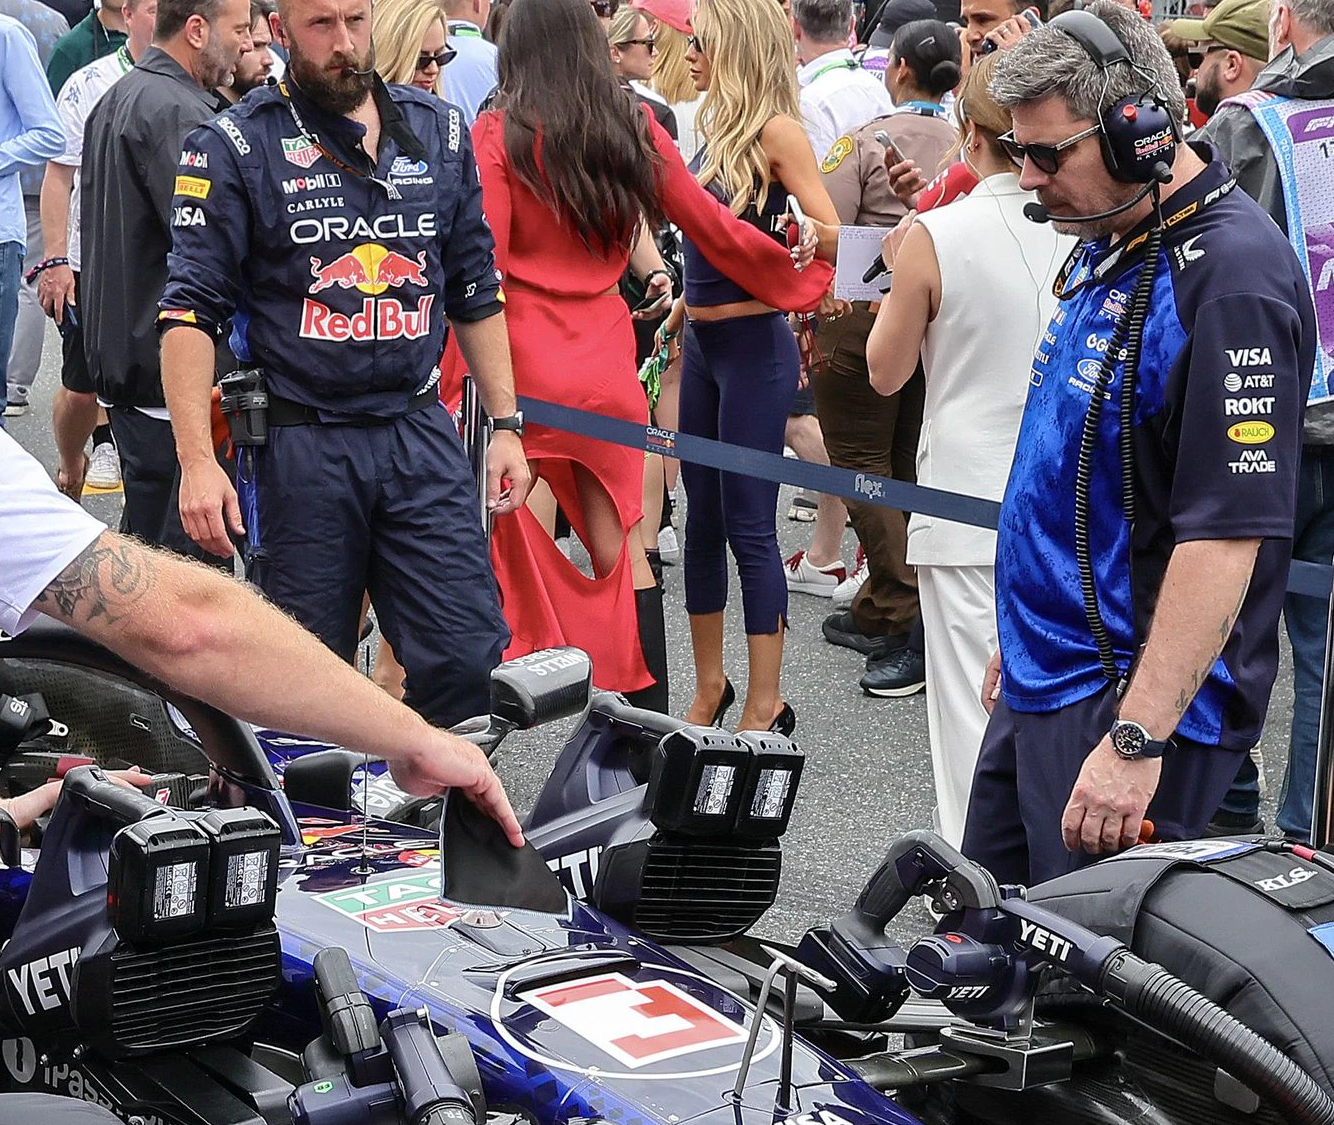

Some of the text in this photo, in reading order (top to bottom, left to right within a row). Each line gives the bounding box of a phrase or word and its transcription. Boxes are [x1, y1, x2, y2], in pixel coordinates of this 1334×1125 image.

[217, 117, 251, 156] sparco
[1134, 126, 1172, 148] ORACLE
[179, 151, 208, 168] Mobil
[391, 157, 420, 173] Ford
[282, 174, 325, 195] Mobil
[286, 196, 345, 213] CARLYLE
[289, 213, 437, 244] ORACLE
[299, 294, 436, 341] Red Bull
[1225, 348, 1273, 367] VISA
[1243, 374, 1275, 389] AT&T
[1224, 397, 1276, 416] ROKT
[1241, 428, 1270, 437] RAUCH
[1239, 450, 1268, 462] AVA
[1228, 460, 1276, 474] TRADE
[1017, 919, 1072, 962] YETI
[946, 984, 991, 1000] YETI
